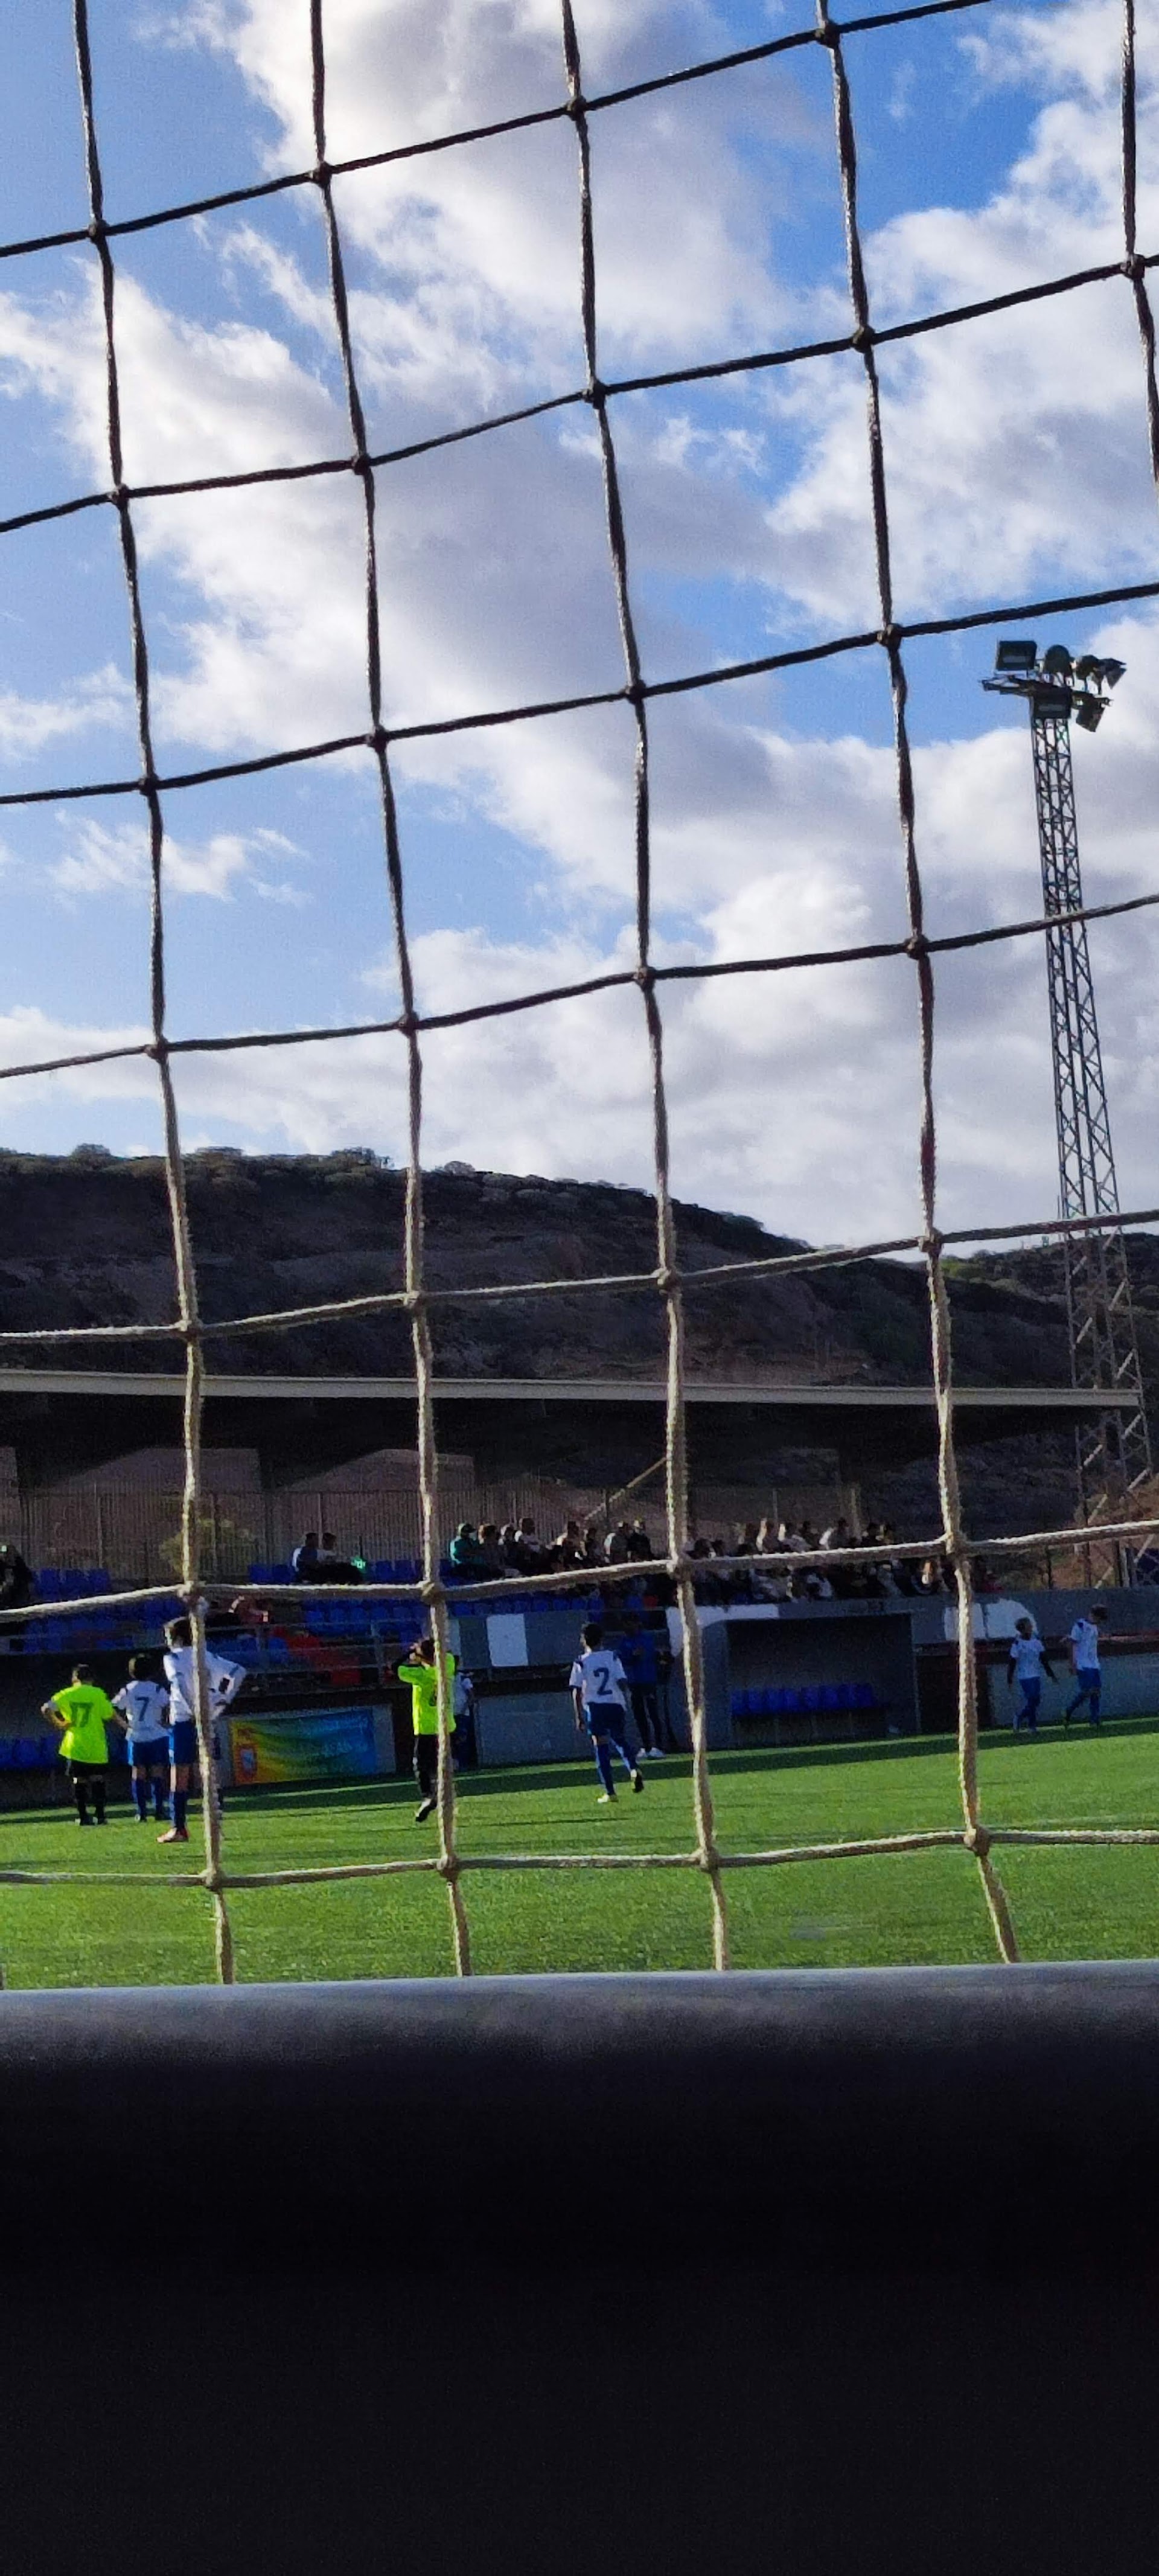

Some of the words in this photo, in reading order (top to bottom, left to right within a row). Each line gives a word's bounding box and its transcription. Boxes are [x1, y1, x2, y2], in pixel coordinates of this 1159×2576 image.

[593, 1667, 613, 1695] 2
[69, 1701, 94, 1728] 17
[135, 1696, 150, 1721] 7
